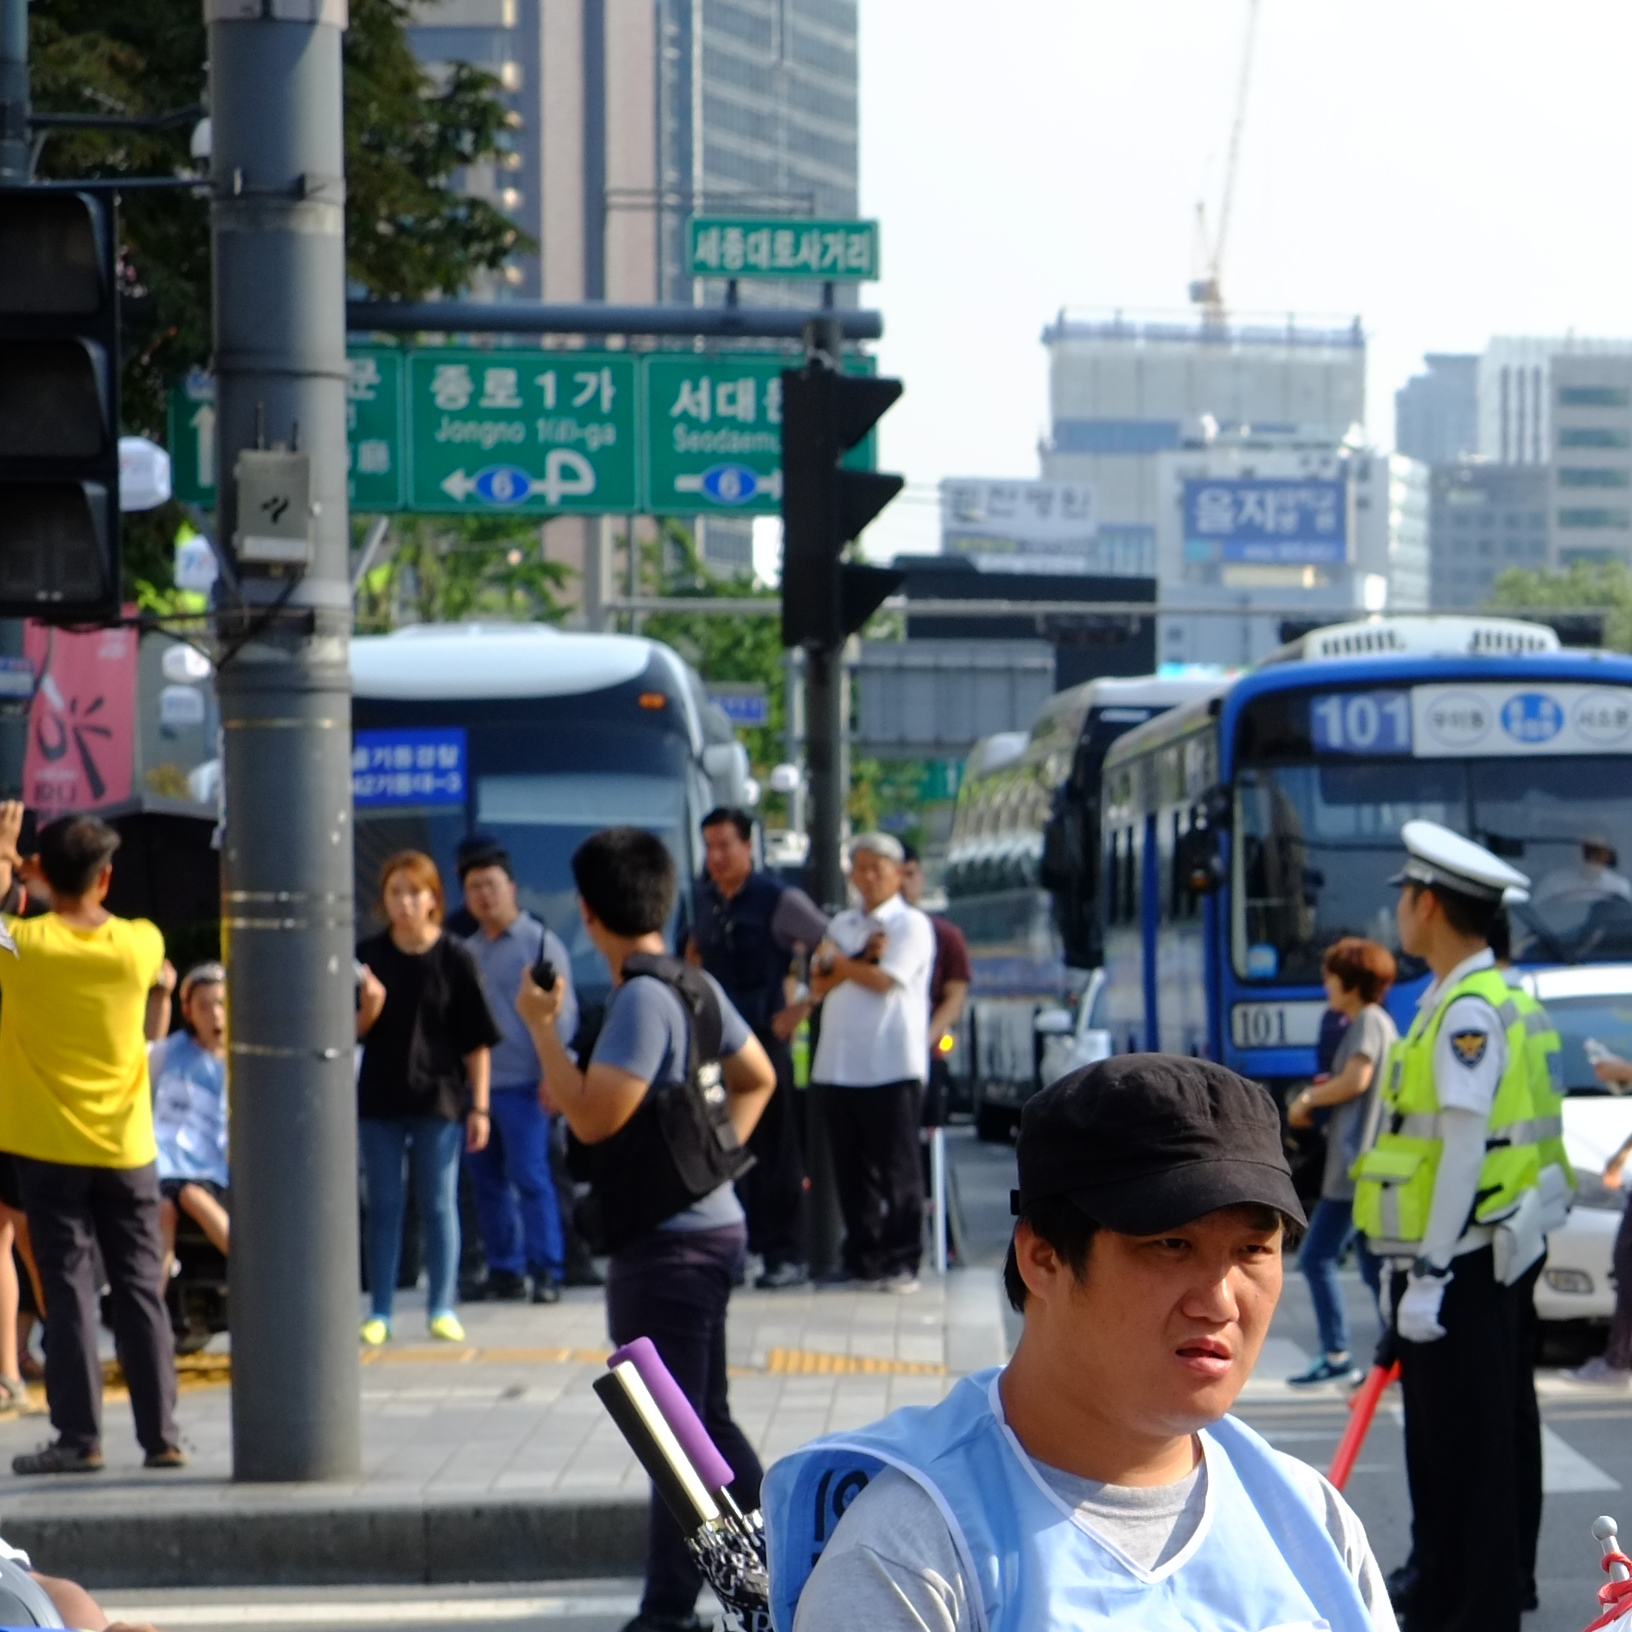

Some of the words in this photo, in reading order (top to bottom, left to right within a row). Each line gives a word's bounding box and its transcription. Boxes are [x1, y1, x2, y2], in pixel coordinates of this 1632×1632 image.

[695, 228, 873, 272] 세종대로사거리
[434, 415, 526, 446] Jongno
[1314, 693, 1412, 750] 101
[1239, 1007, 1288, 1042] 101
